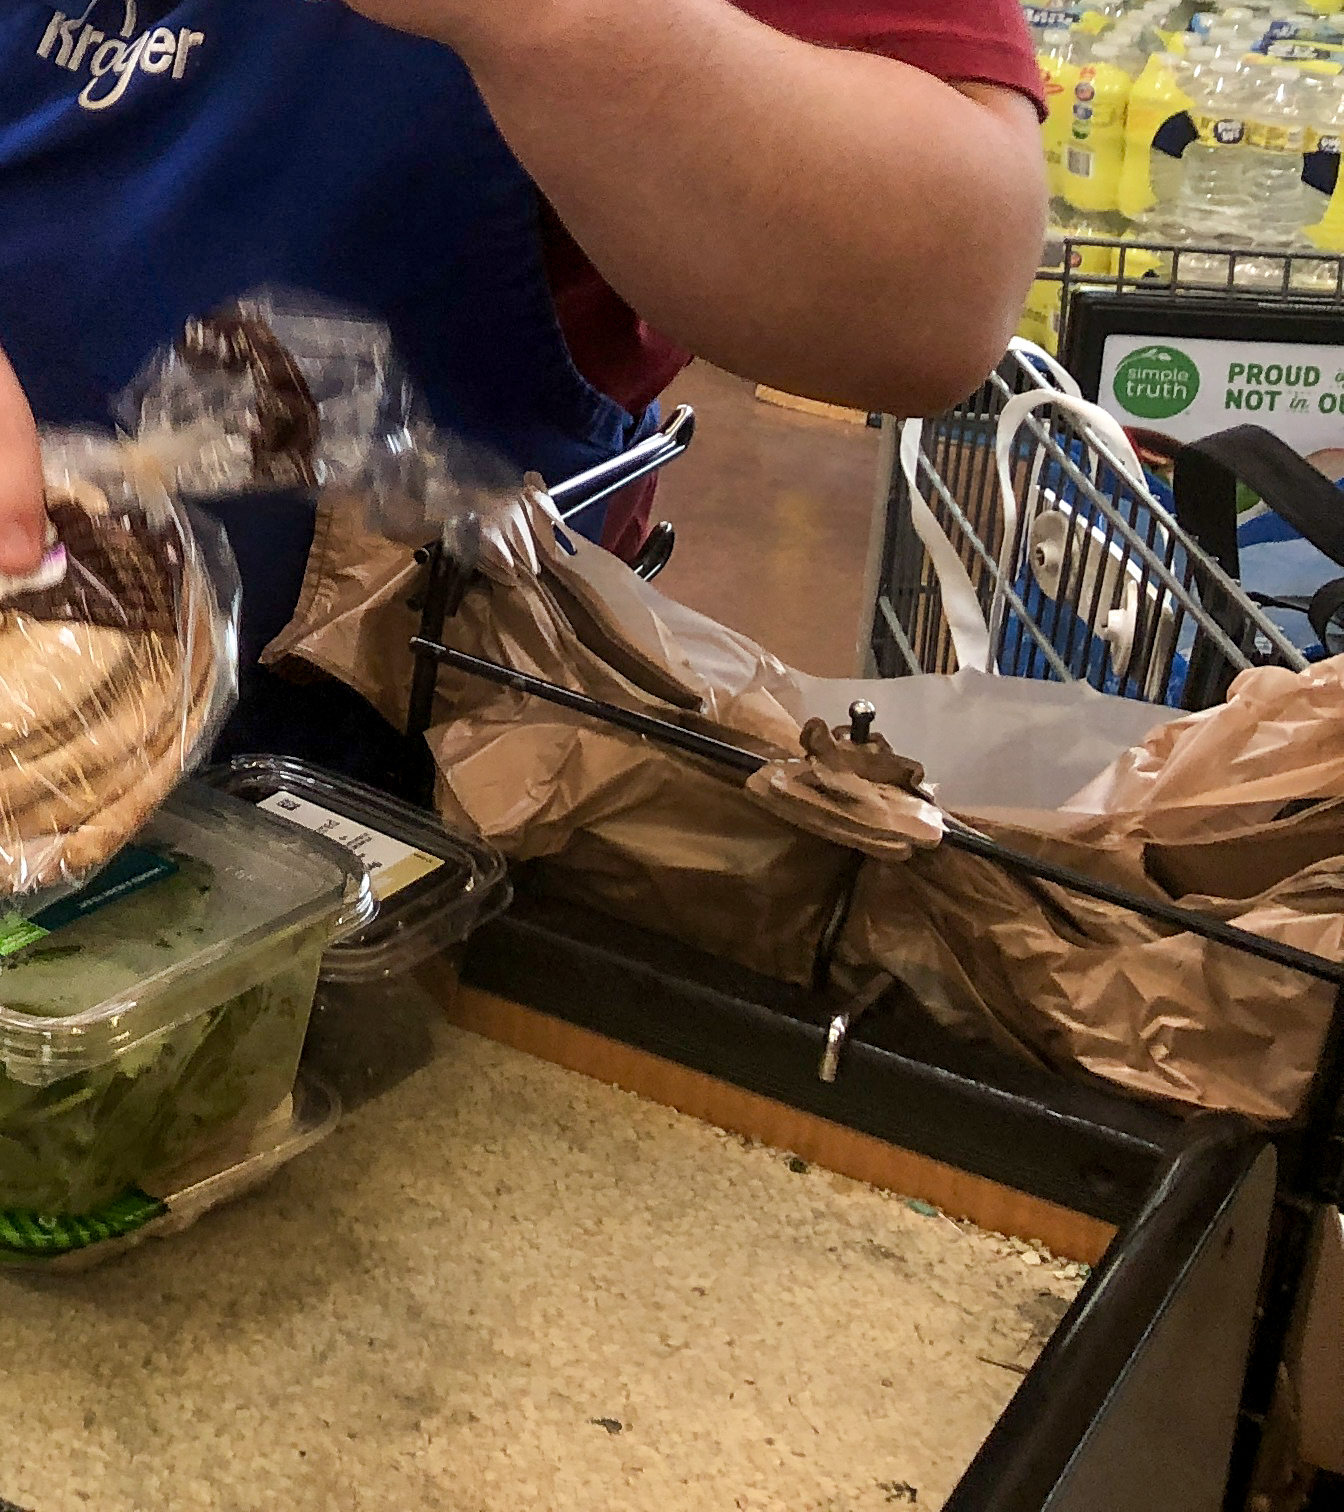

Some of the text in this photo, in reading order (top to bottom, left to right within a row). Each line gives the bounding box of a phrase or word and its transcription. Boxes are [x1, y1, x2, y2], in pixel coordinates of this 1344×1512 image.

[1127, 367, 1190, 384] simple
[1228, 362, 1321, 388] PROUD
[1126, 380, 1189, 400] truth
[1225, 388, 1282, 412] NOT
[1288, 392, 1310, 413] in
